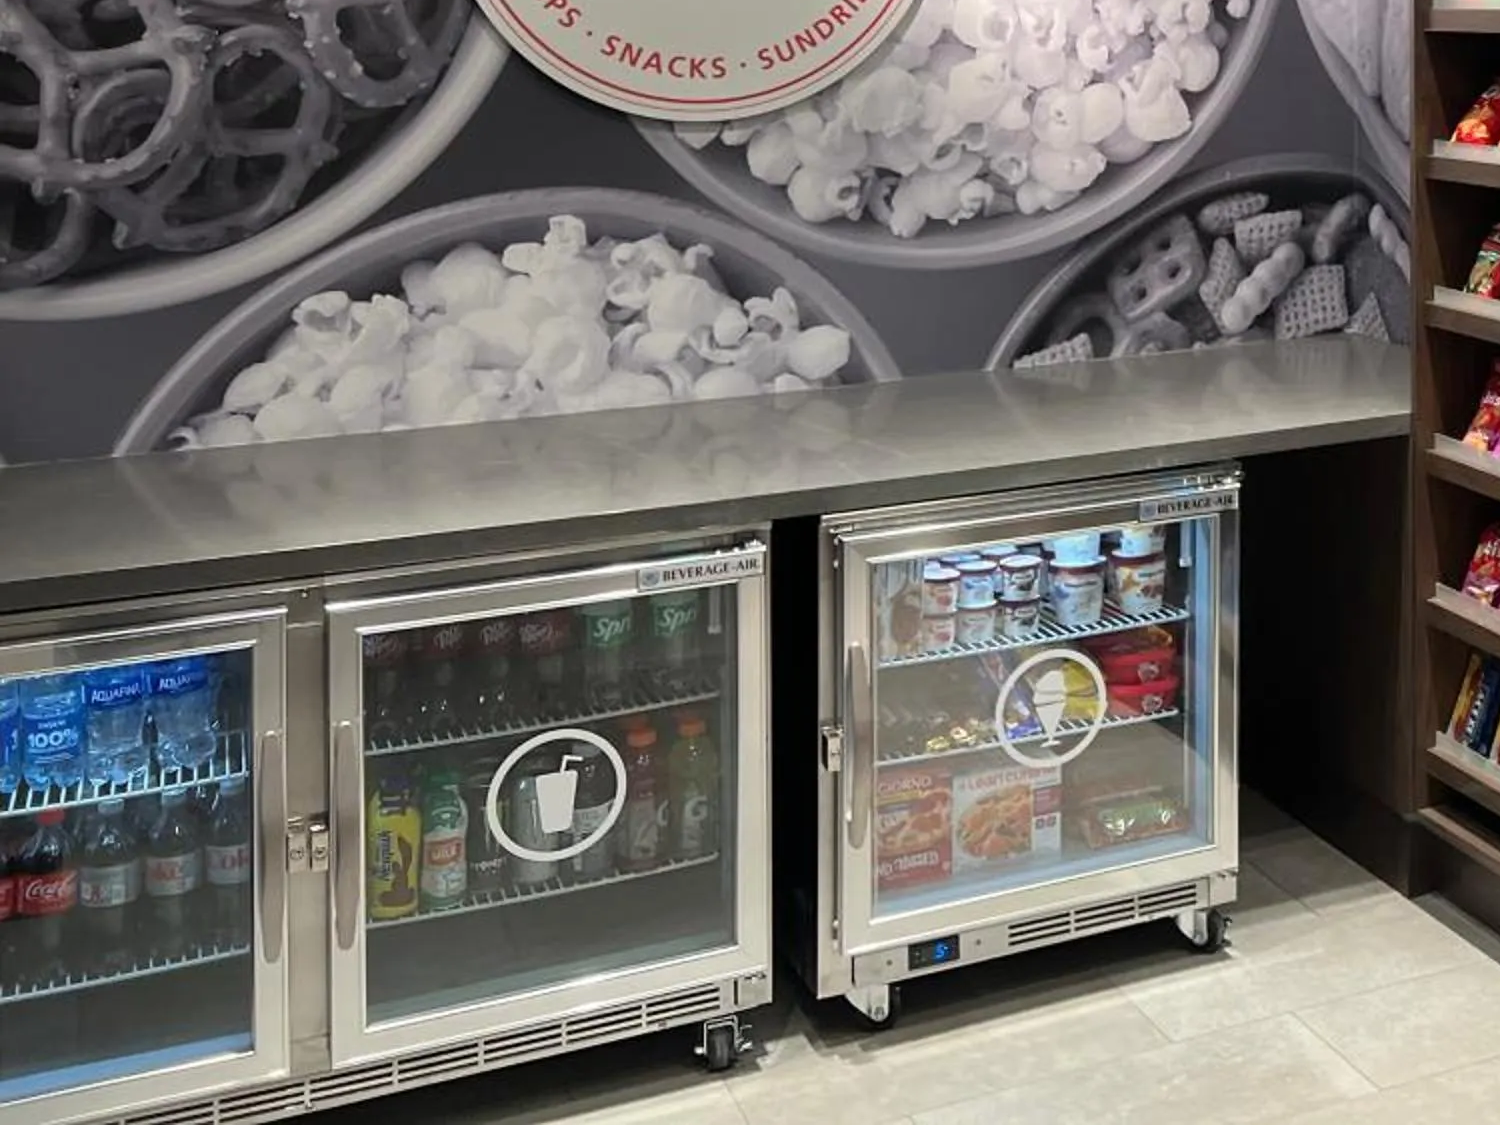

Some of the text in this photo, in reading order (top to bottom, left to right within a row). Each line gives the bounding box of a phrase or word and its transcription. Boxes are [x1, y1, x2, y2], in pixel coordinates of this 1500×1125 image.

[599, 35, 728, 80] SNACKS
[662, 558, 759, 582] BEVERAGE-AIR
[27, 727, 80, 750] 100%
